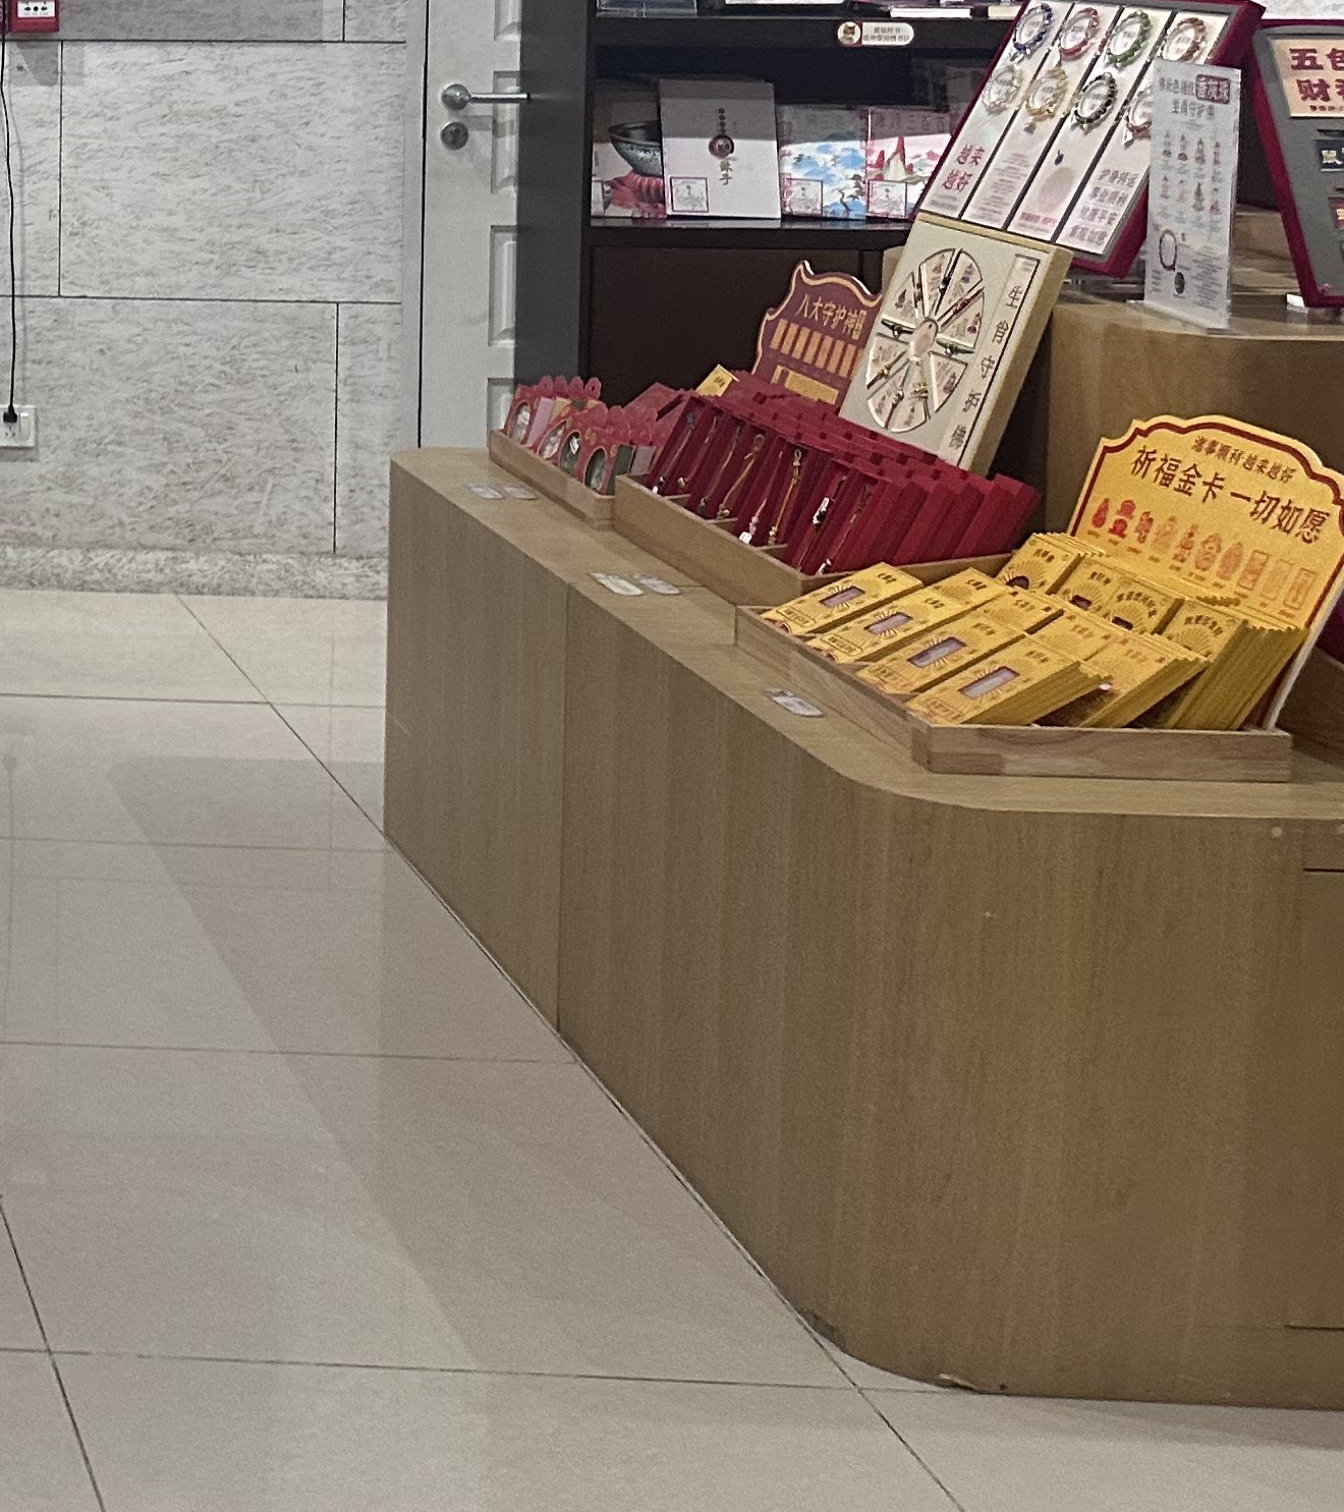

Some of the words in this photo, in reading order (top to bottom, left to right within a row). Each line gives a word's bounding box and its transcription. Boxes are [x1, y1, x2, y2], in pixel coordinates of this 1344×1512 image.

[795, 293, 858, 336] 八大守护神
[1131, 445, 1226, 504] 祈福金卡
[1230, 489, 1330, 544] 一切如愿
